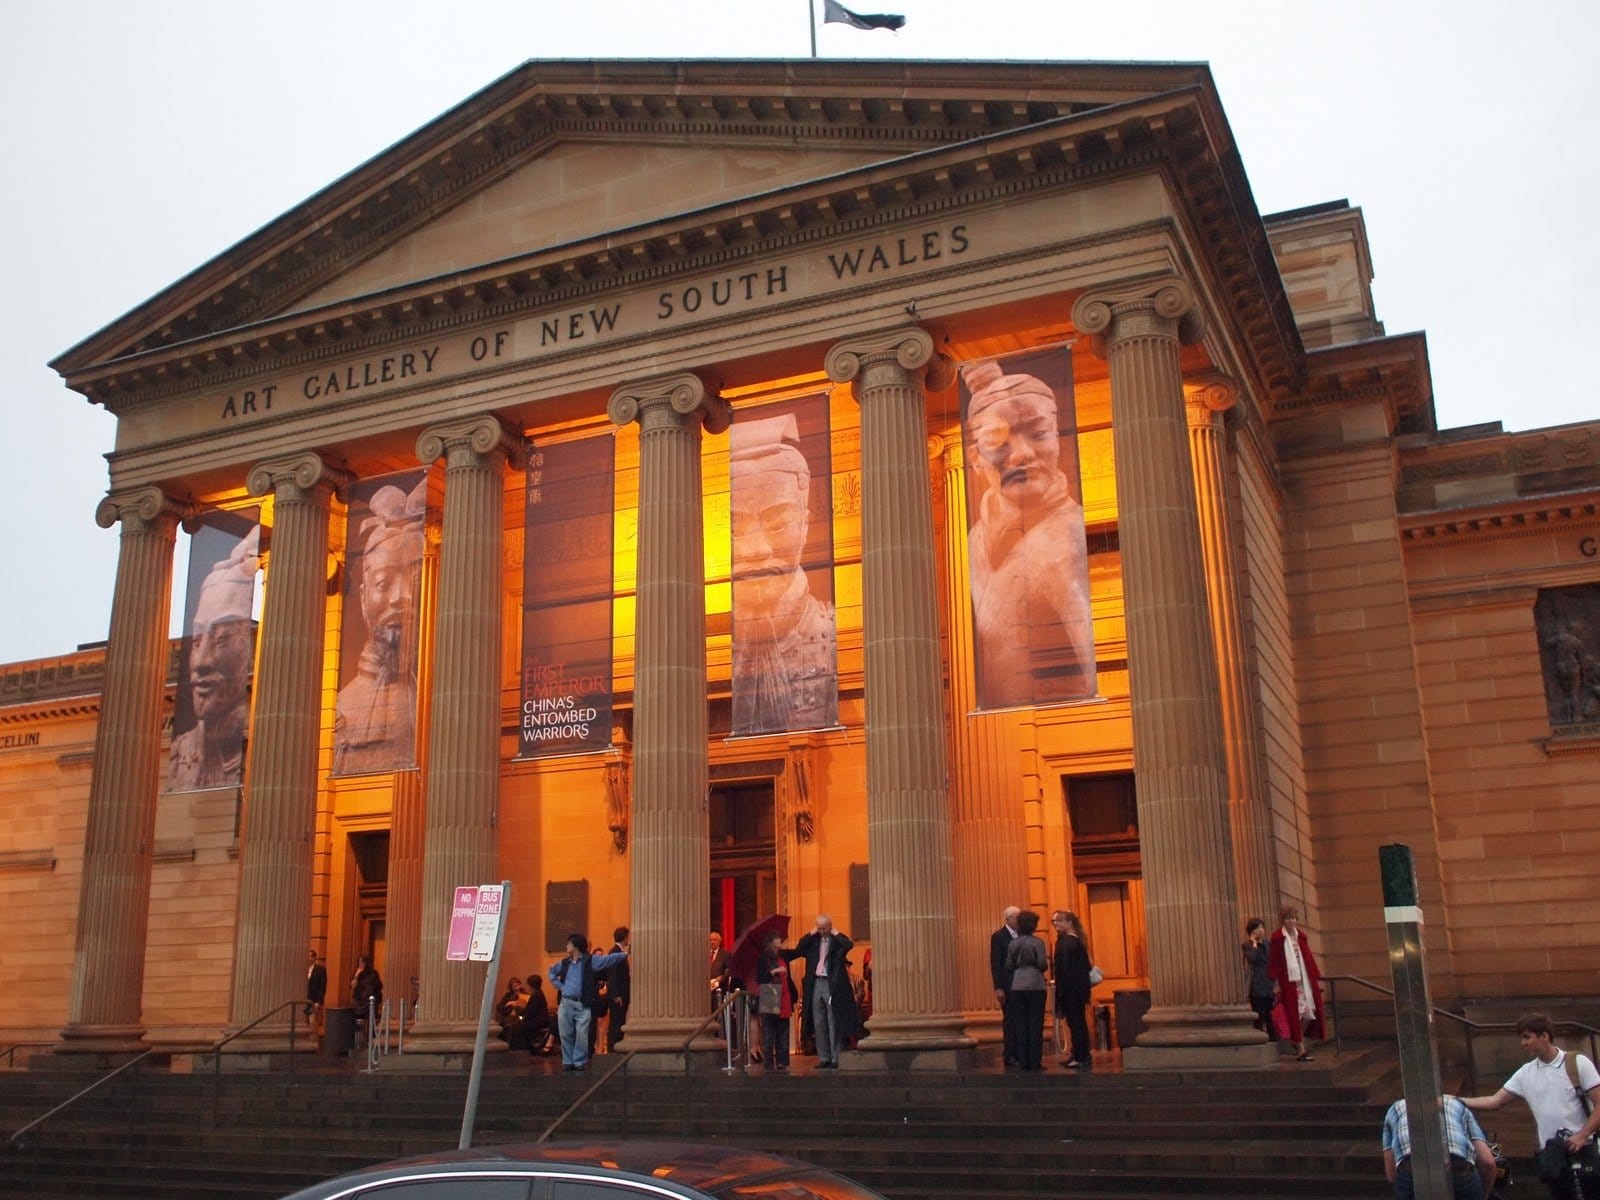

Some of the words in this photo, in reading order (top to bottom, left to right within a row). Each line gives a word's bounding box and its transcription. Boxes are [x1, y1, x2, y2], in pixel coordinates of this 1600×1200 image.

[221, 385, 277, 419] ART
[303, 347, 440, 399] GALLERY
[470, 331, 510, 361] OF
[541, 304, 622, 346] NEW
[657, 266, 789, 319] SOUTH
[828, 225, 969, 280] WALES
[525, 675, 608, 700] EMPEROR
[523, 695, 574, 713] CHINA'S
[523, 708, 597, 728] ENTOMBED
[523, 723, 590, 742] WARRIORS
[461, 893, 472, 903] NO
[482, 892, 498, 902] BUS
[478, 903, 499, 914] ZONE
